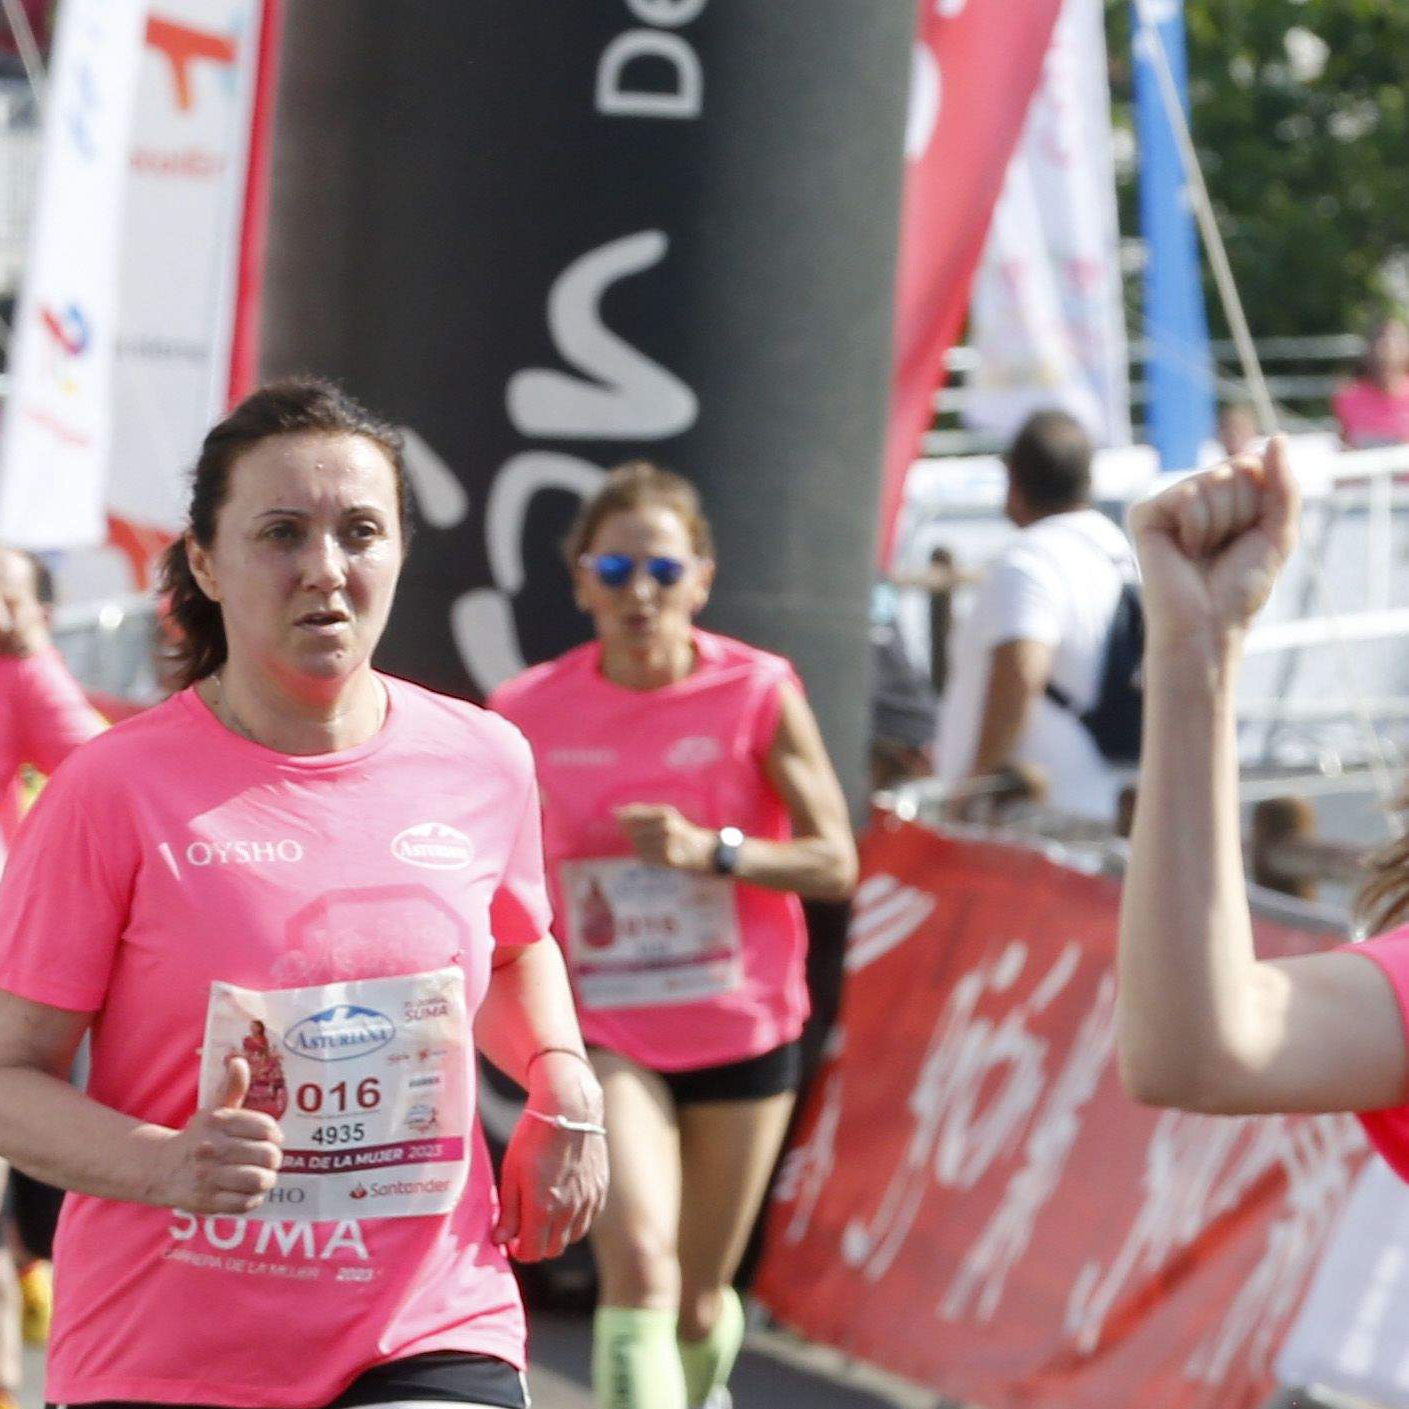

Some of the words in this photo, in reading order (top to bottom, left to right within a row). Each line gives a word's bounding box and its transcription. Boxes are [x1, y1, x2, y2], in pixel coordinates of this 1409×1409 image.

[186, 838, 304, 866] OYSHO
[296, 1077, 382, 1113] 016
[311, 1123, 365, 1145] 4935
[370, 1179, 450, 1196] Santander
[168, 1208, 370, 1261] SUMA
